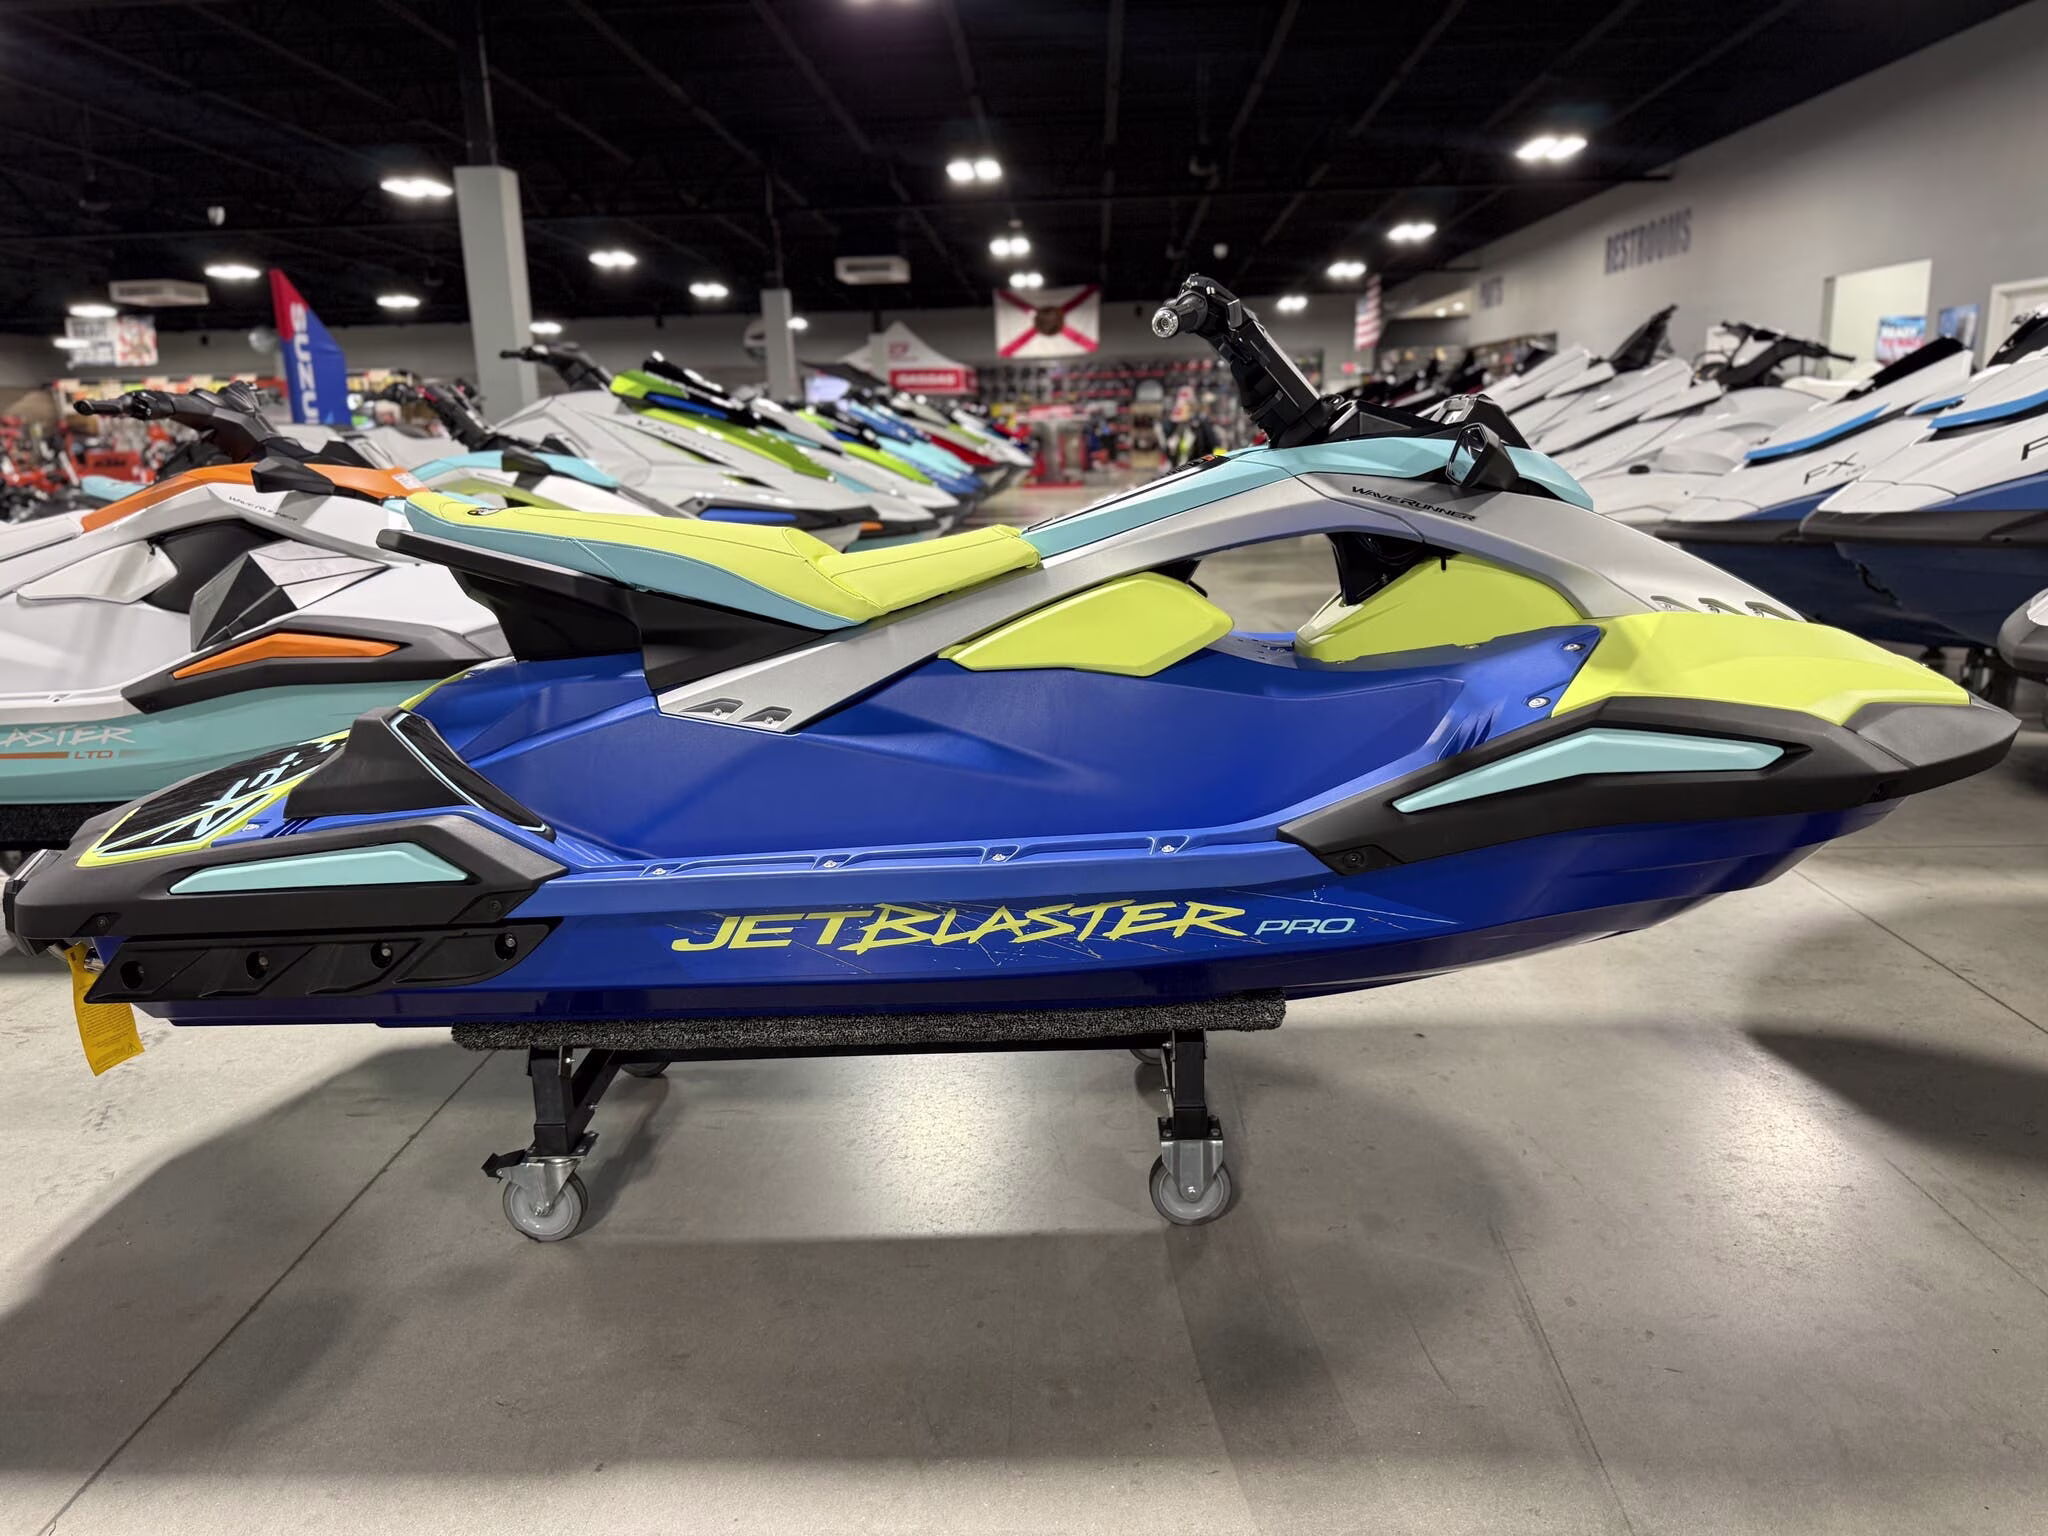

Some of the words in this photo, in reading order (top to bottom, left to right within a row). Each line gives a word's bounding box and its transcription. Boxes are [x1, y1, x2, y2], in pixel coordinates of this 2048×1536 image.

[1605, 208, 1691, 274] RESTROOMS
[290, 302, 320, 425] SUZU
[1803, 451, 1859, 486] FX
[1352, 486, 1476, 521] WAVERUNNER
[0, 724, 137, 747] ASTER
[1255, 917, 1356, 936] PRO
